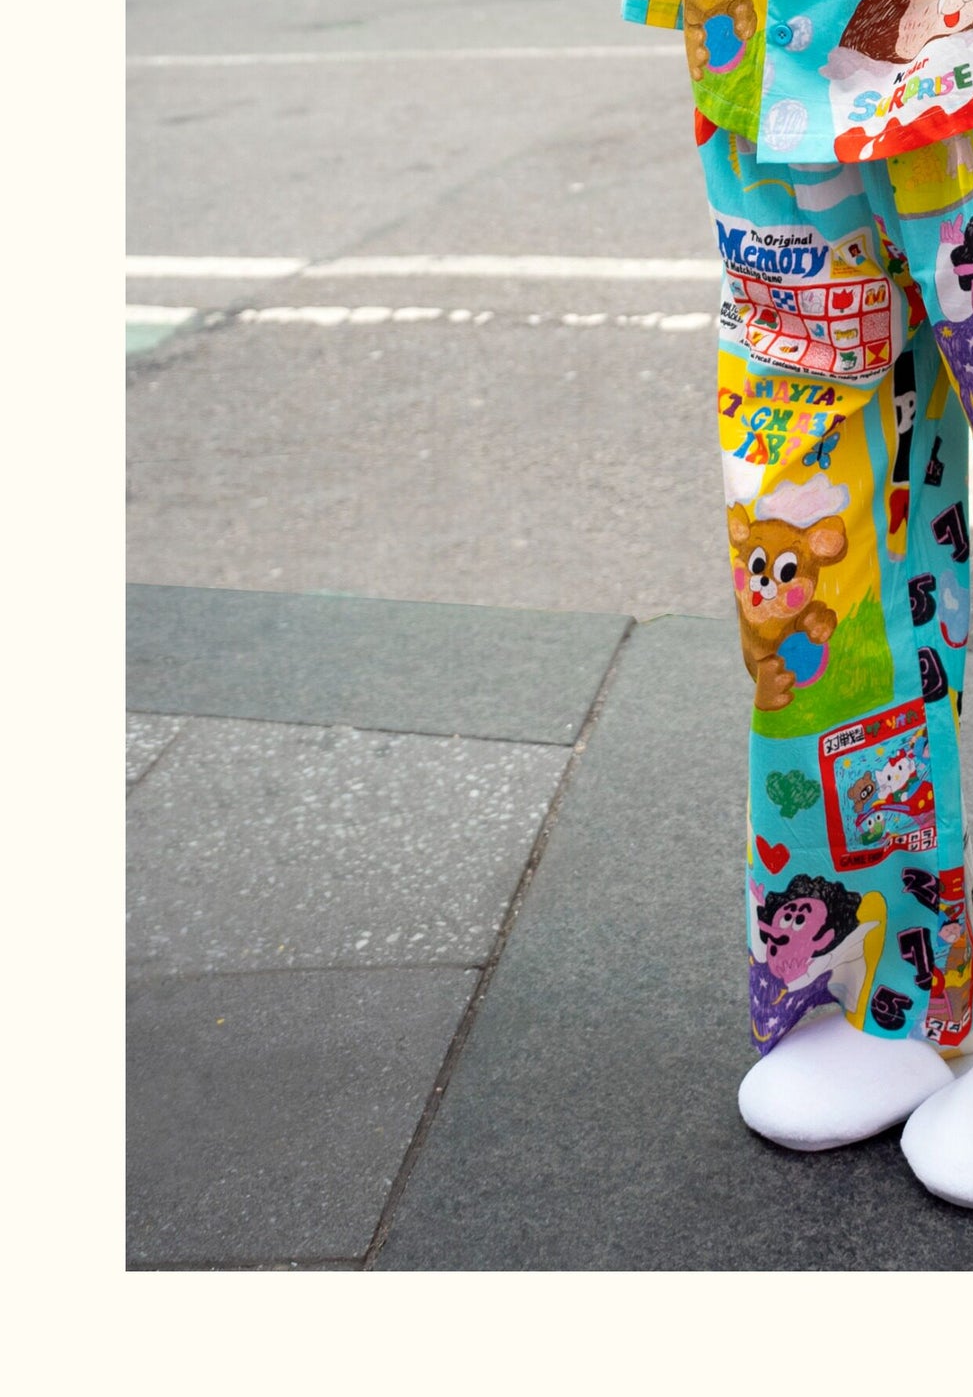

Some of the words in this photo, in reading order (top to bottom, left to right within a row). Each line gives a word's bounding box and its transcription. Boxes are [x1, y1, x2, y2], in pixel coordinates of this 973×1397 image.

[848, 63, 973, 122] SURPRISE
[716, 219, 829, 278] Memory
[764, 233, 813, 249] Original
